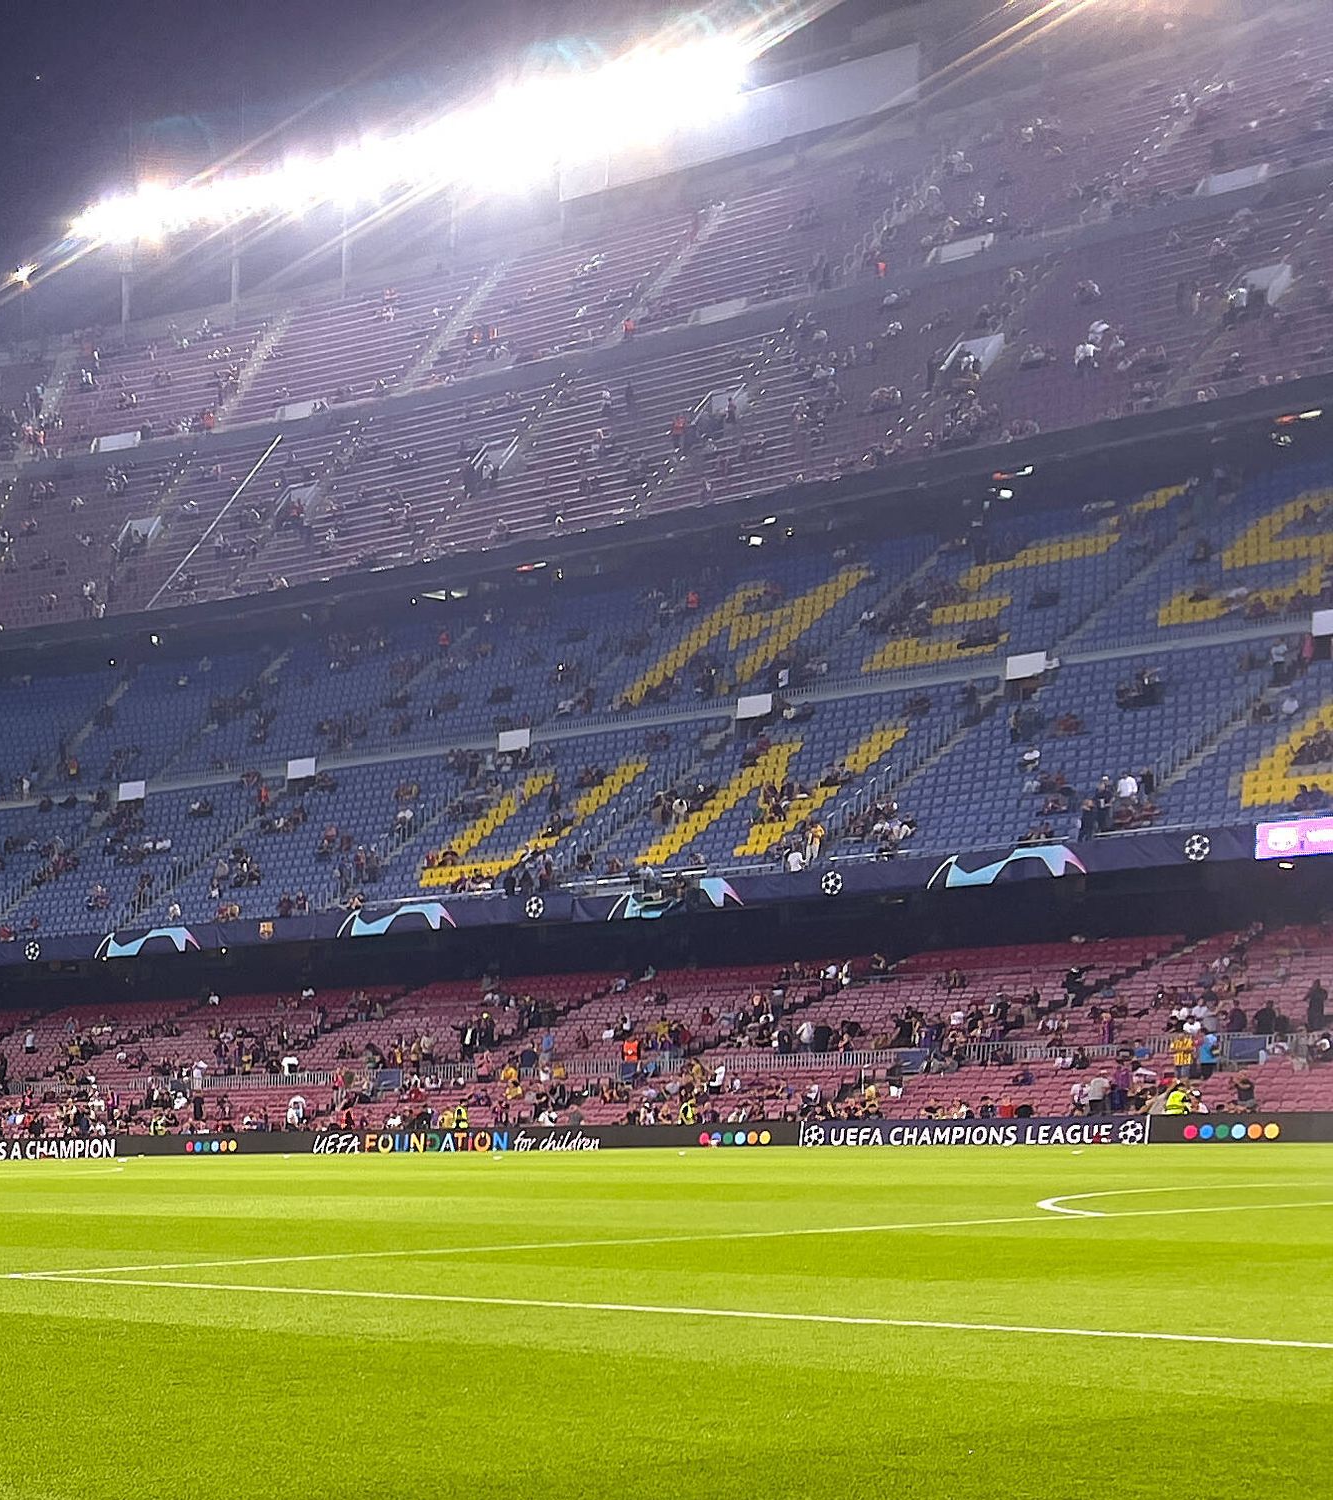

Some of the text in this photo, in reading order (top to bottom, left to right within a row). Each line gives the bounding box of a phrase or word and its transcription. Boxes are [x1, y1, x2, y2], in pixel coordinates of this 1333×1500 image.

[313, 1133, 360, 1154] UEFA
[514, 1130, 537, 1152] for
[538, 1130, 601, 1152] children
[830, 1124, 1113, 1147] UEFA CHAMPIONS LEAGUE
[10, 1141, 22, 1160] A
[25, 1138, 116, 1160] CHAMPION
